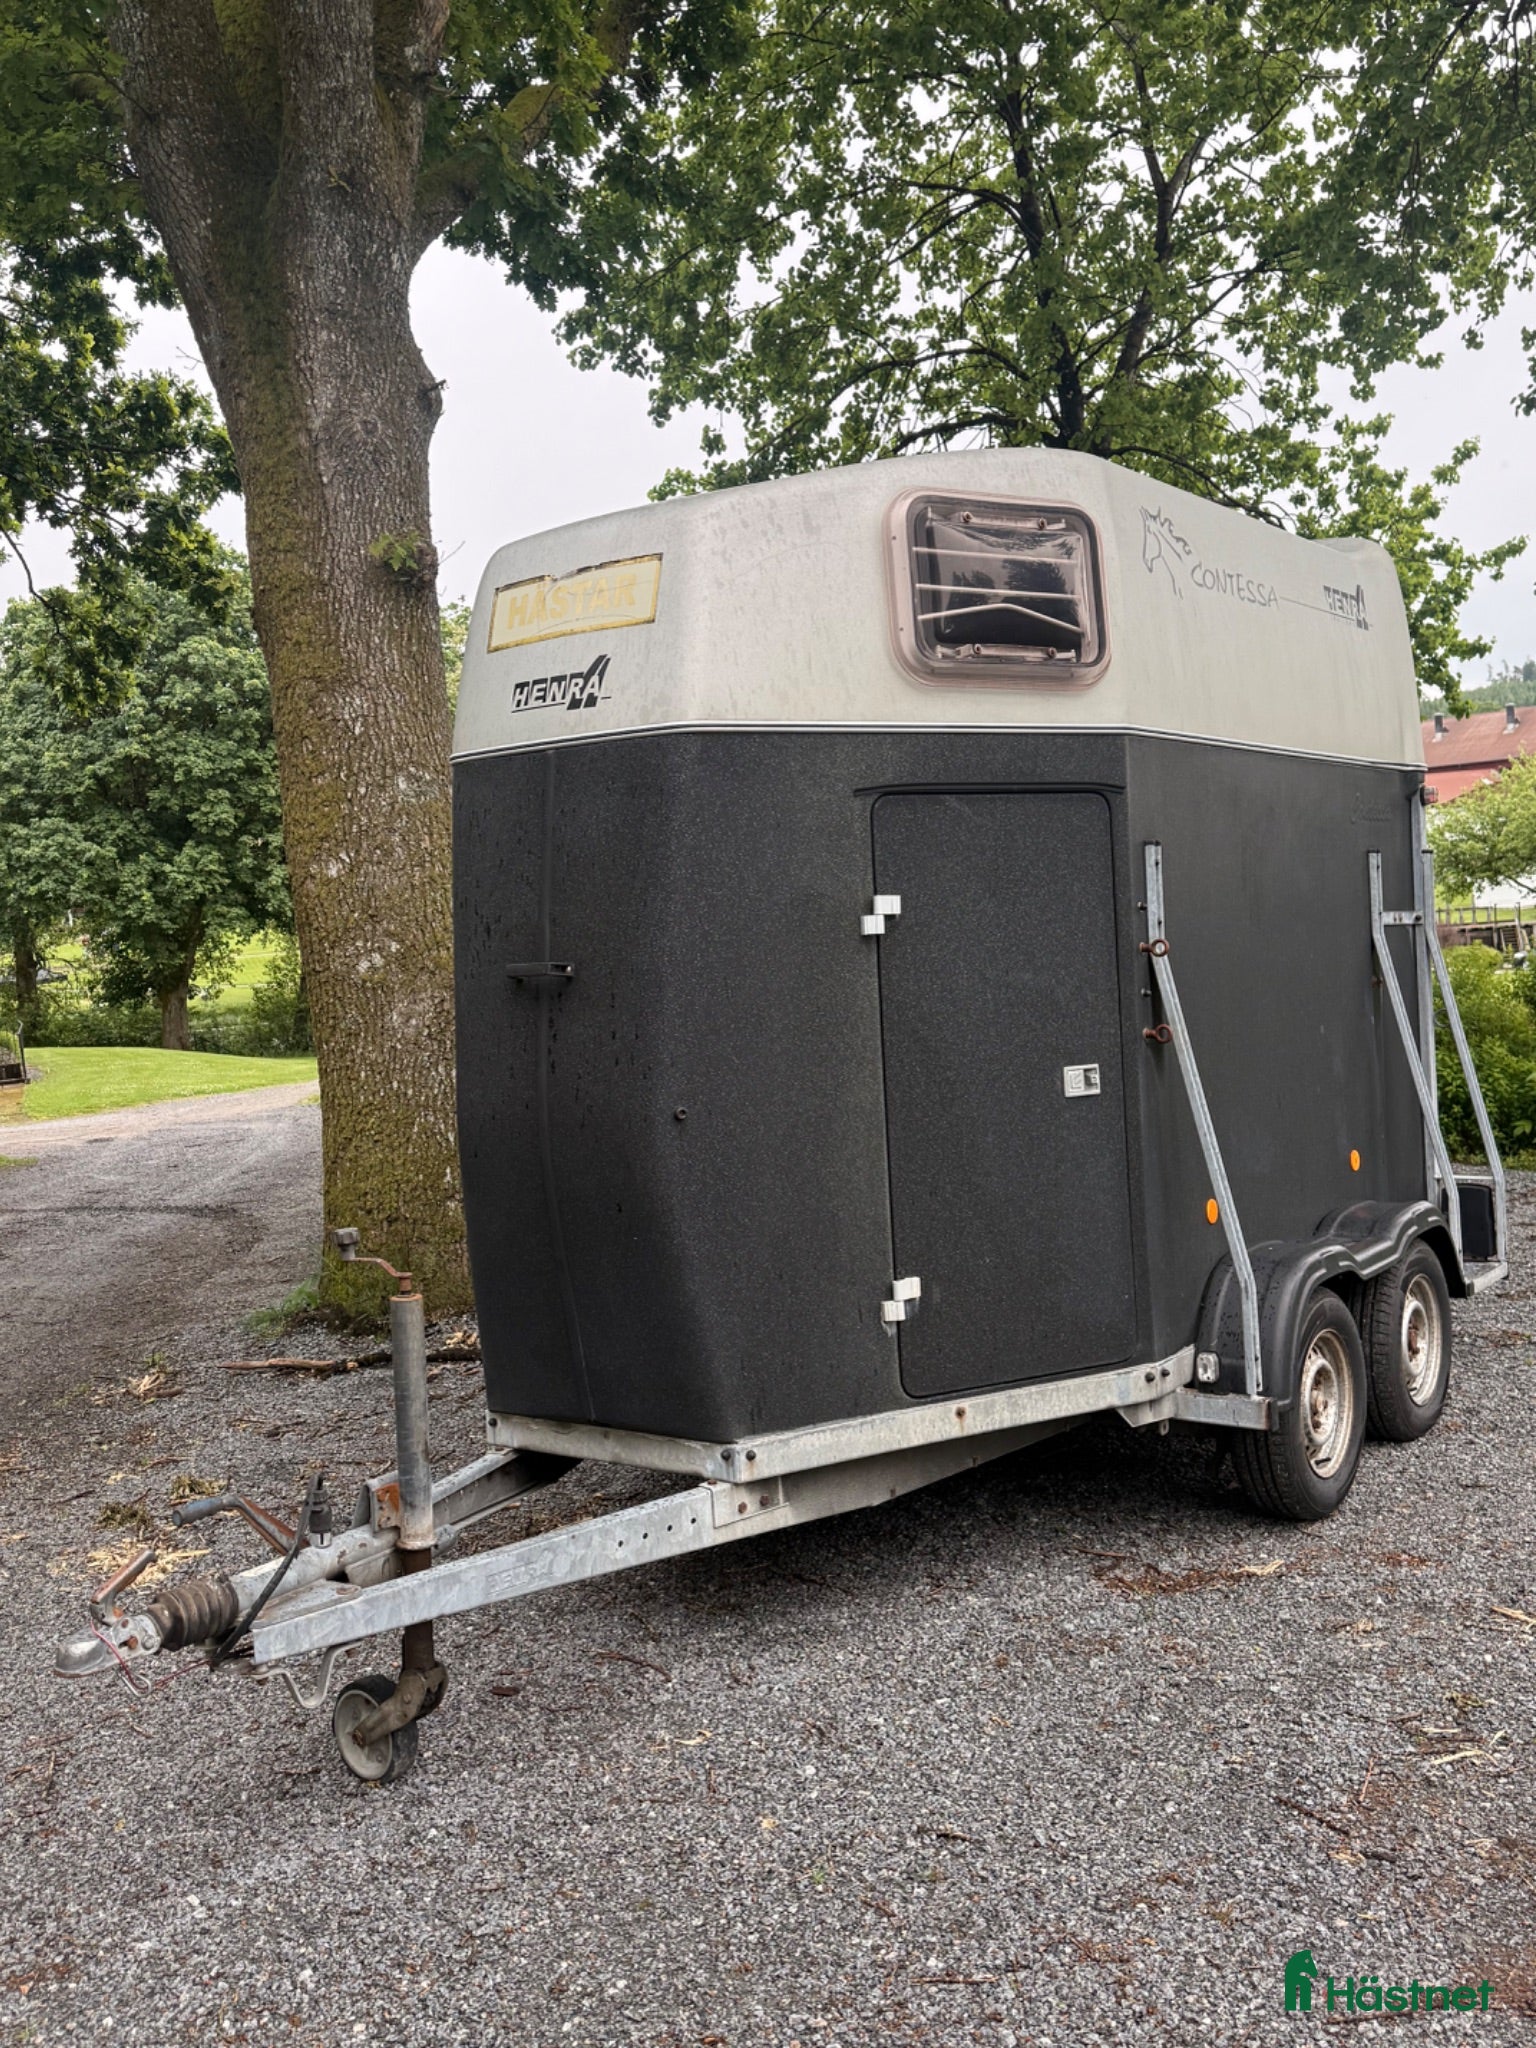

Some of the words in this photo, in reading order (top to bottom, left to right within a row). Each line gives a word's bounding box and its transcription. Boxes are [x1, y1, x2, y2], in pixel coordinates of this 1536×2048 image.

[507, 573, 637, 630] HÄSTAR
[1191, 562, 1280, 610] CONTESSA
[511, 654, 611, 711] HENRA
